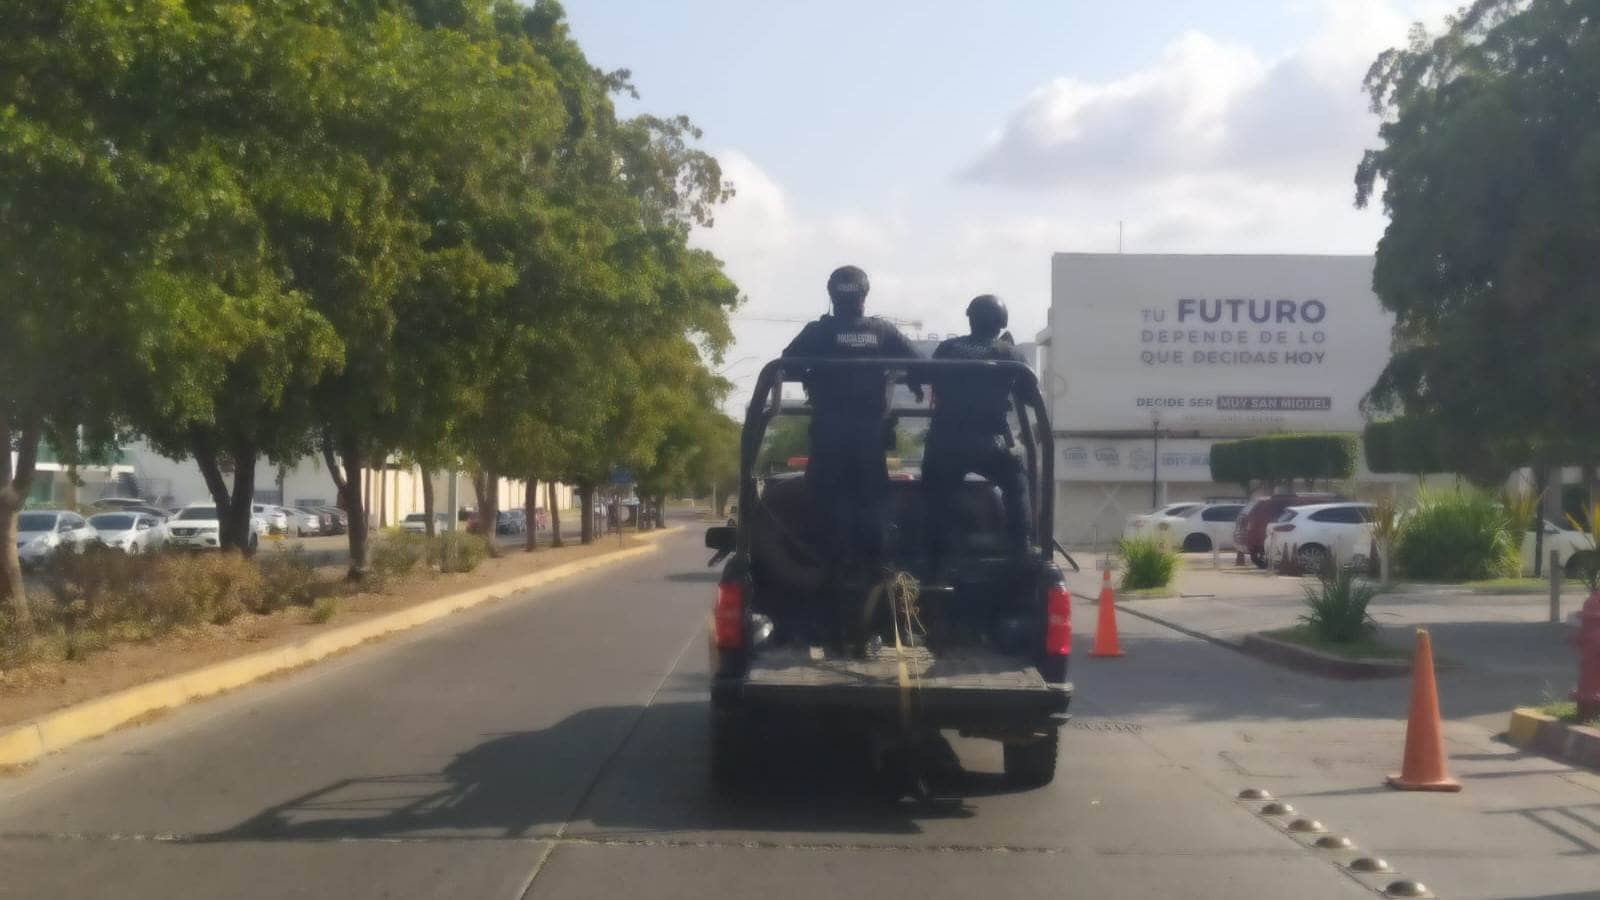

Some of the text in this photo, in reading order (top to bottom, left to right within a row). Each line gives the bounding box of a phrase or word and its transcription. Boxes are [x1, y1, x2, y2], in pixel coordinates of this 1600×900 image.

[1141, 298, 1327, 324] TU FUTURO
[1141, 330, 1327, 344] DEPENDE DE LO
[1140, 350, 1326, 366] QUE DECIDAS HOY
[1136, 397, 1331, 410] DECIDE SER MUY SAN MIGUEL
